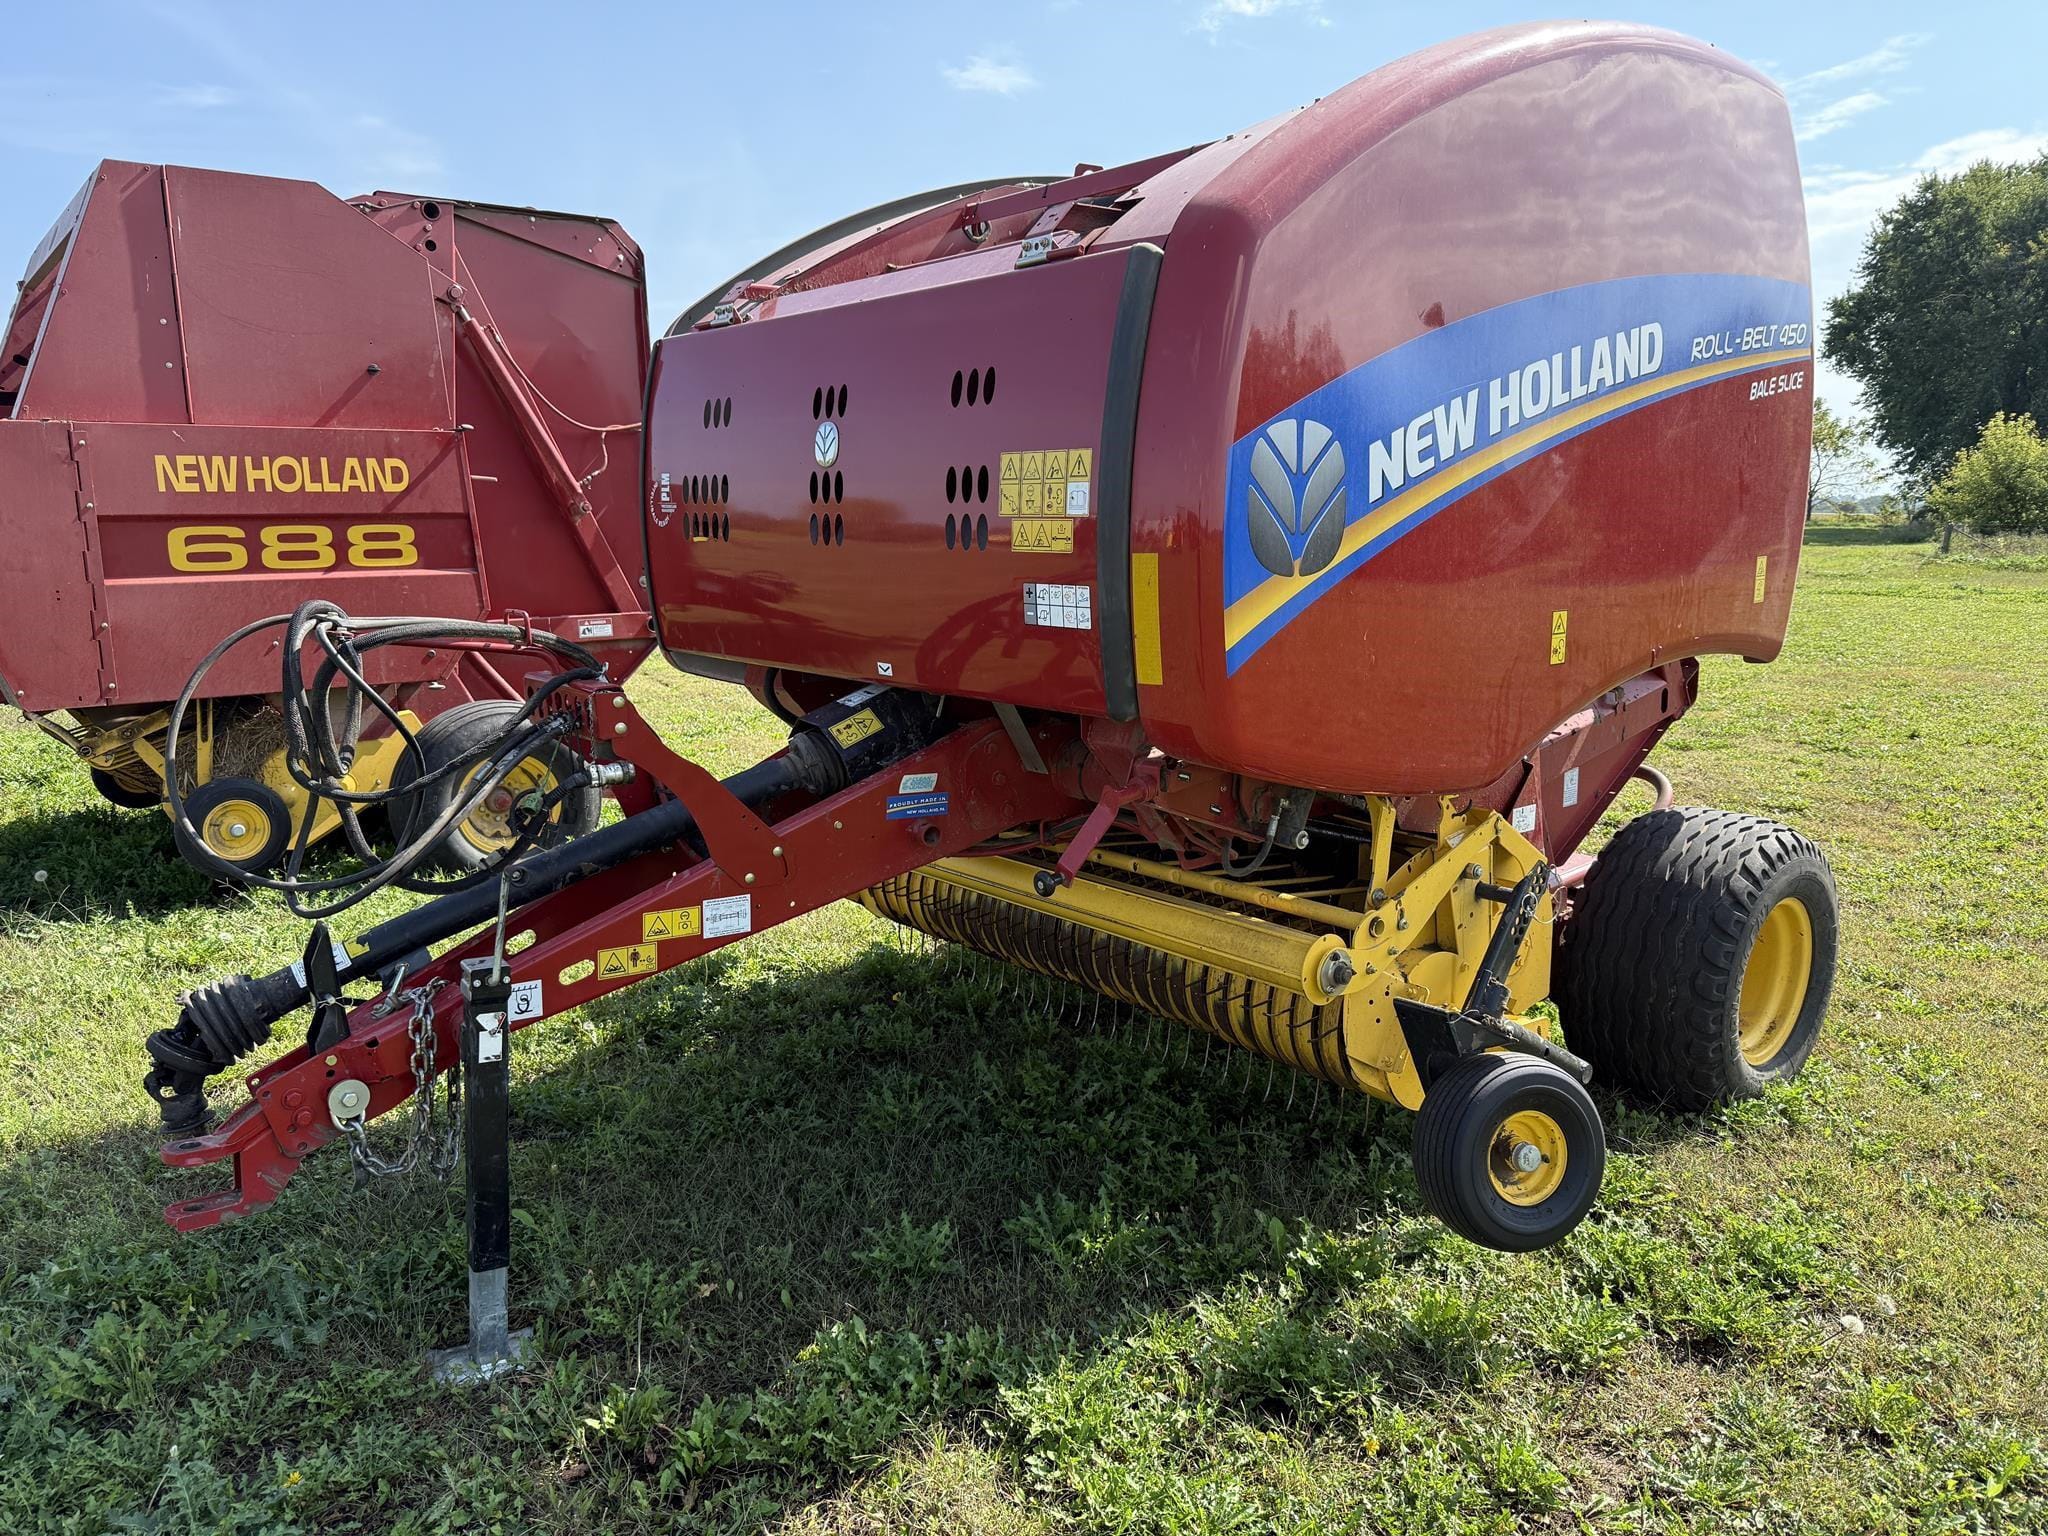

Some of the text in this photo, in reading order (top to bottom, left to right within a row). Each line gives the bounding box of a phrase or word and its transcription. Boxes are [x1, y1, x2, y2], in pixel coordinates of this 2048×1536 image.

[1690, 323, 1807, 362] ROLL-BELT 450
[1749, 371, 1804, 400] BALE SLICE
[1369, 322, 1664, 504] NEW HOLLAND
[154, 454, 410, 493] NEW HOLLAND
[661, 473, 670, 501] PLM
[167, 523, 419, 572] 688
[890, 799, 918, 808] PROUDLY
